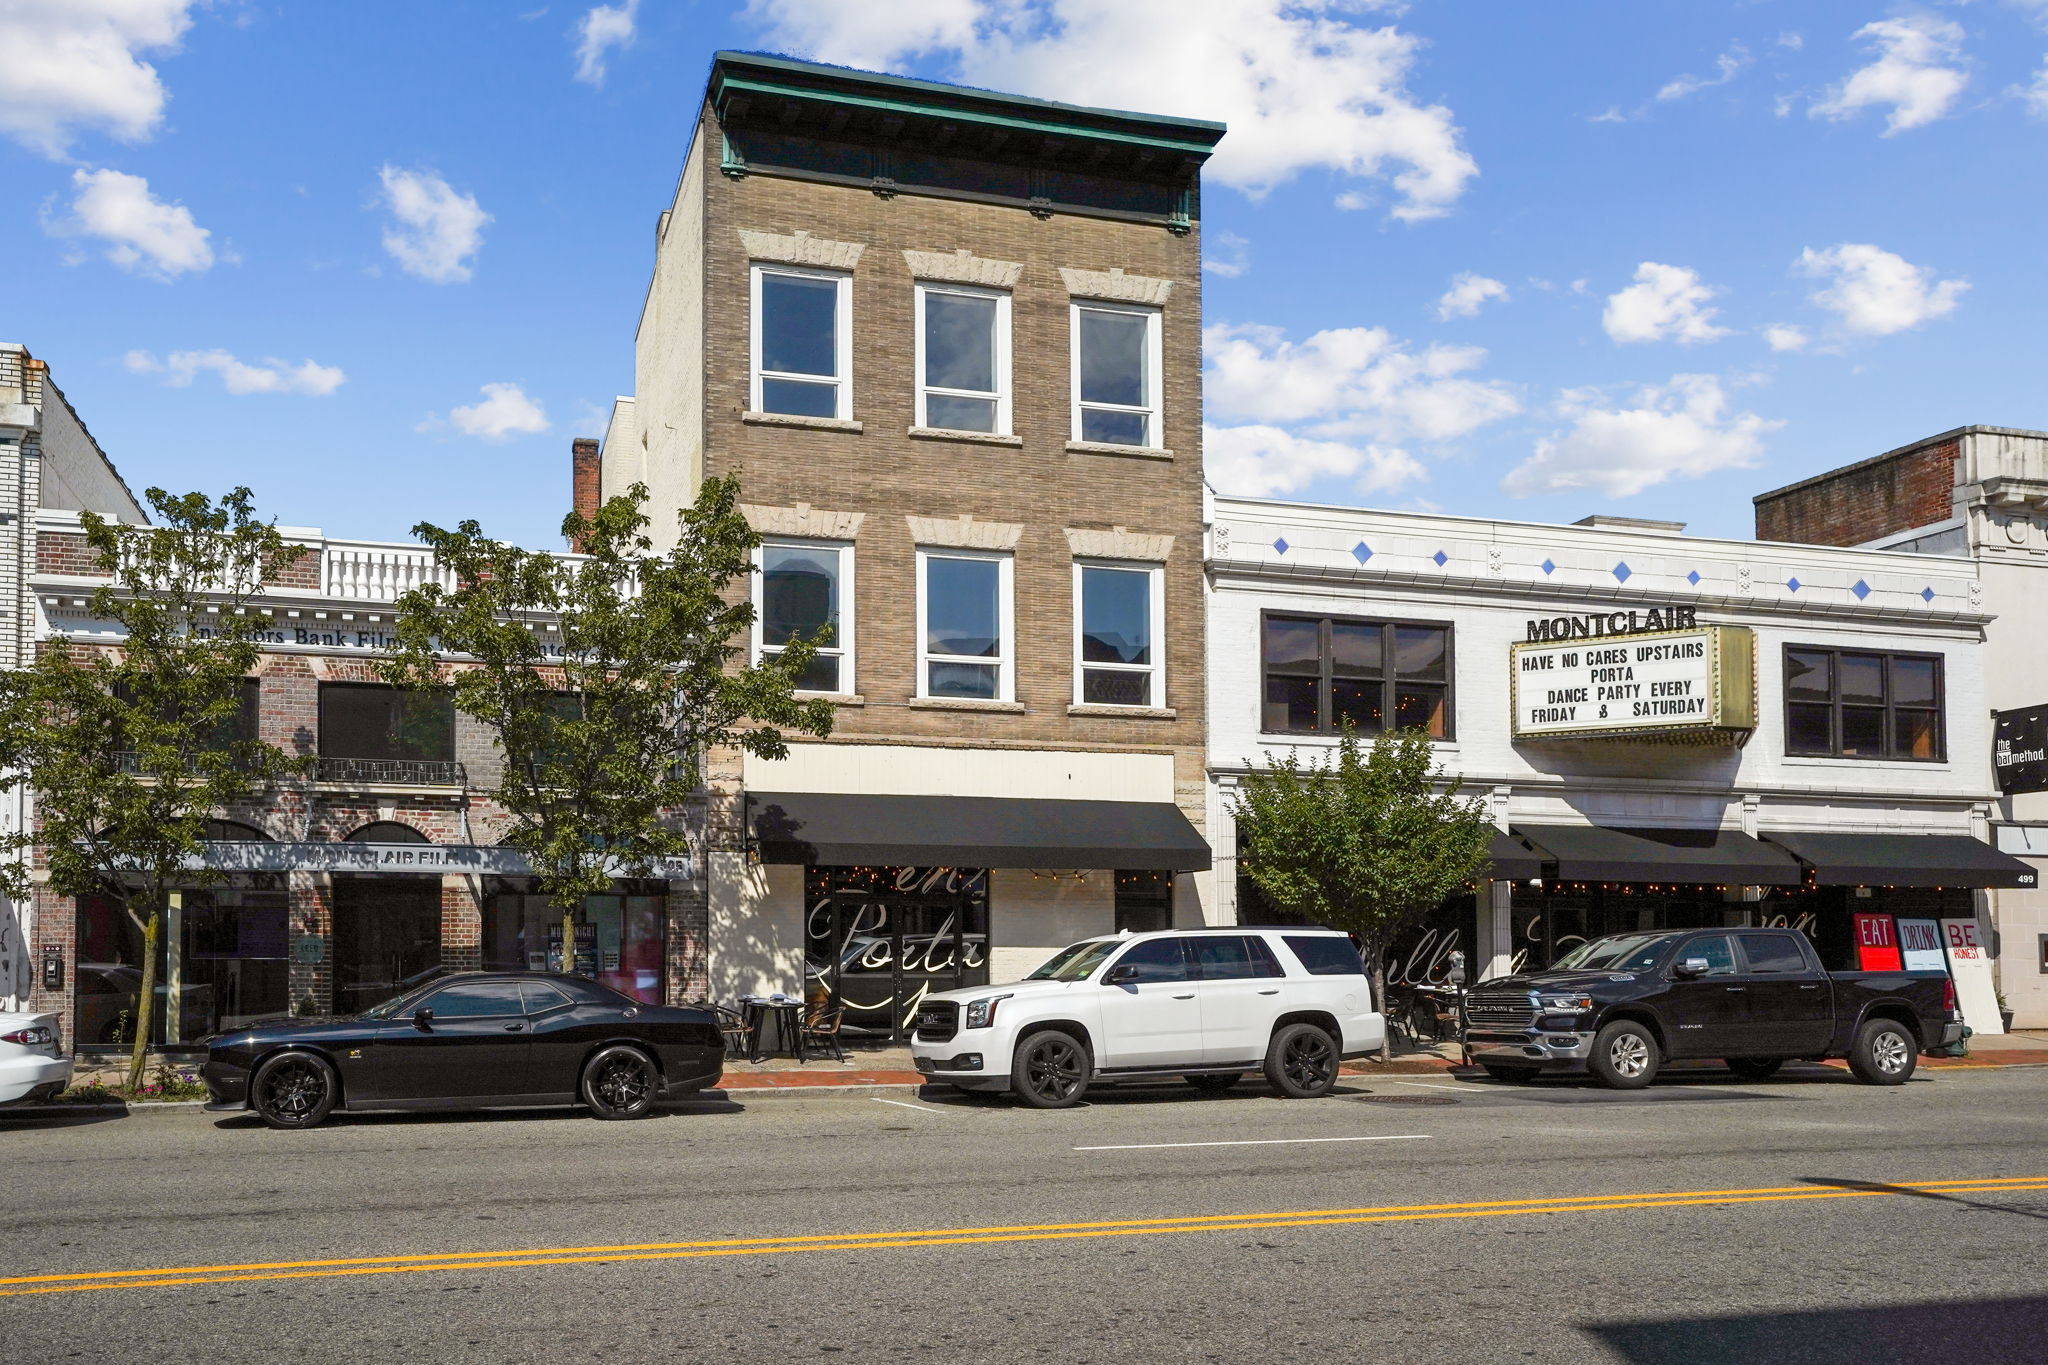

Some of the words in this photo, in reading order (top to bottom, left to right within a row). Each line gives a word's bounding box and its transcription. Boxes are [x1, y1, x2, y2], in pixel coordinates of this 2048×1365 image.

[1527, 606, 1697, 642] MONTCLAIR
[295, 628, 347, 646] Bank
[1522, 655, 1554, 671] HAVE
[1562, 653, 1578, 668] NO
[1586, 649, 1628, 666] CARES
[1636, 643, 1704, 662] UPSTAIRS
[1591, 667, 1634, 683] PORTA
[1548, 688, 1588, 705] DANCE
[1599, 684, 1641, 701] PARTY
[1651, 681, 1692, 697] EVERY
[1531, 707, 1576, 723] FRIDAY
[1633, 698, 1705, 717] SATURDAY
[1997, 739, 2010, 751] the
[1997, 752, 2012, 766] bar
[419, 851, 458, 865] FILM
[2018, 875, 2034, 883] 499
[1861, 919, 1889, 945] EAT
[1903, 924, 1938, 950] DRINK
[1948, 924, 1977, 947] BE
[1953, 948, 1979, 960] HONEST
